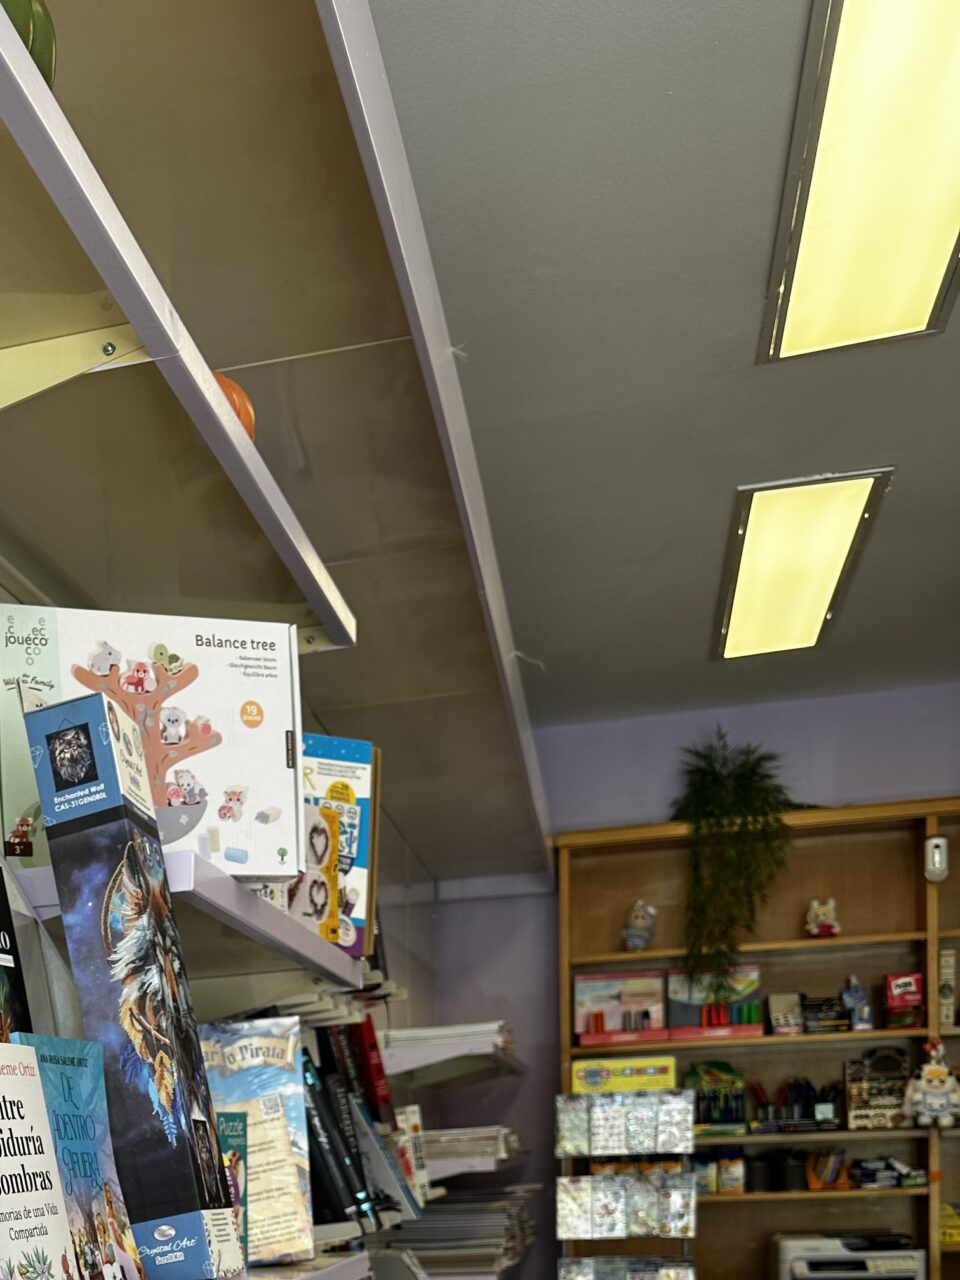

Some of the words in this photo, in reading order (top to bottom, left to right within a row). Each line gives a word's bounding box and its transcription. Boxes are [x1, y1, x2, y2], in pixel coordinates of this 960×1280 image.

[195, 633, 248, 650] Balance
[250, 638, 277, 651] tree
[246, 704, 258, 716] 19
[54, 787, 89, 804] Enchanted
[90, 782, 106, 795] Wolf
[18, 1063, 37, 1077] Ortiz
[23, 1206, 33, 1219] de
[33, 1208, 45, 1218] una
[45, 1203, 58, 1216] Vida
[9, 1223, 49, 1242] Compartida
[137, 1243, 173, 1258] Crystal
